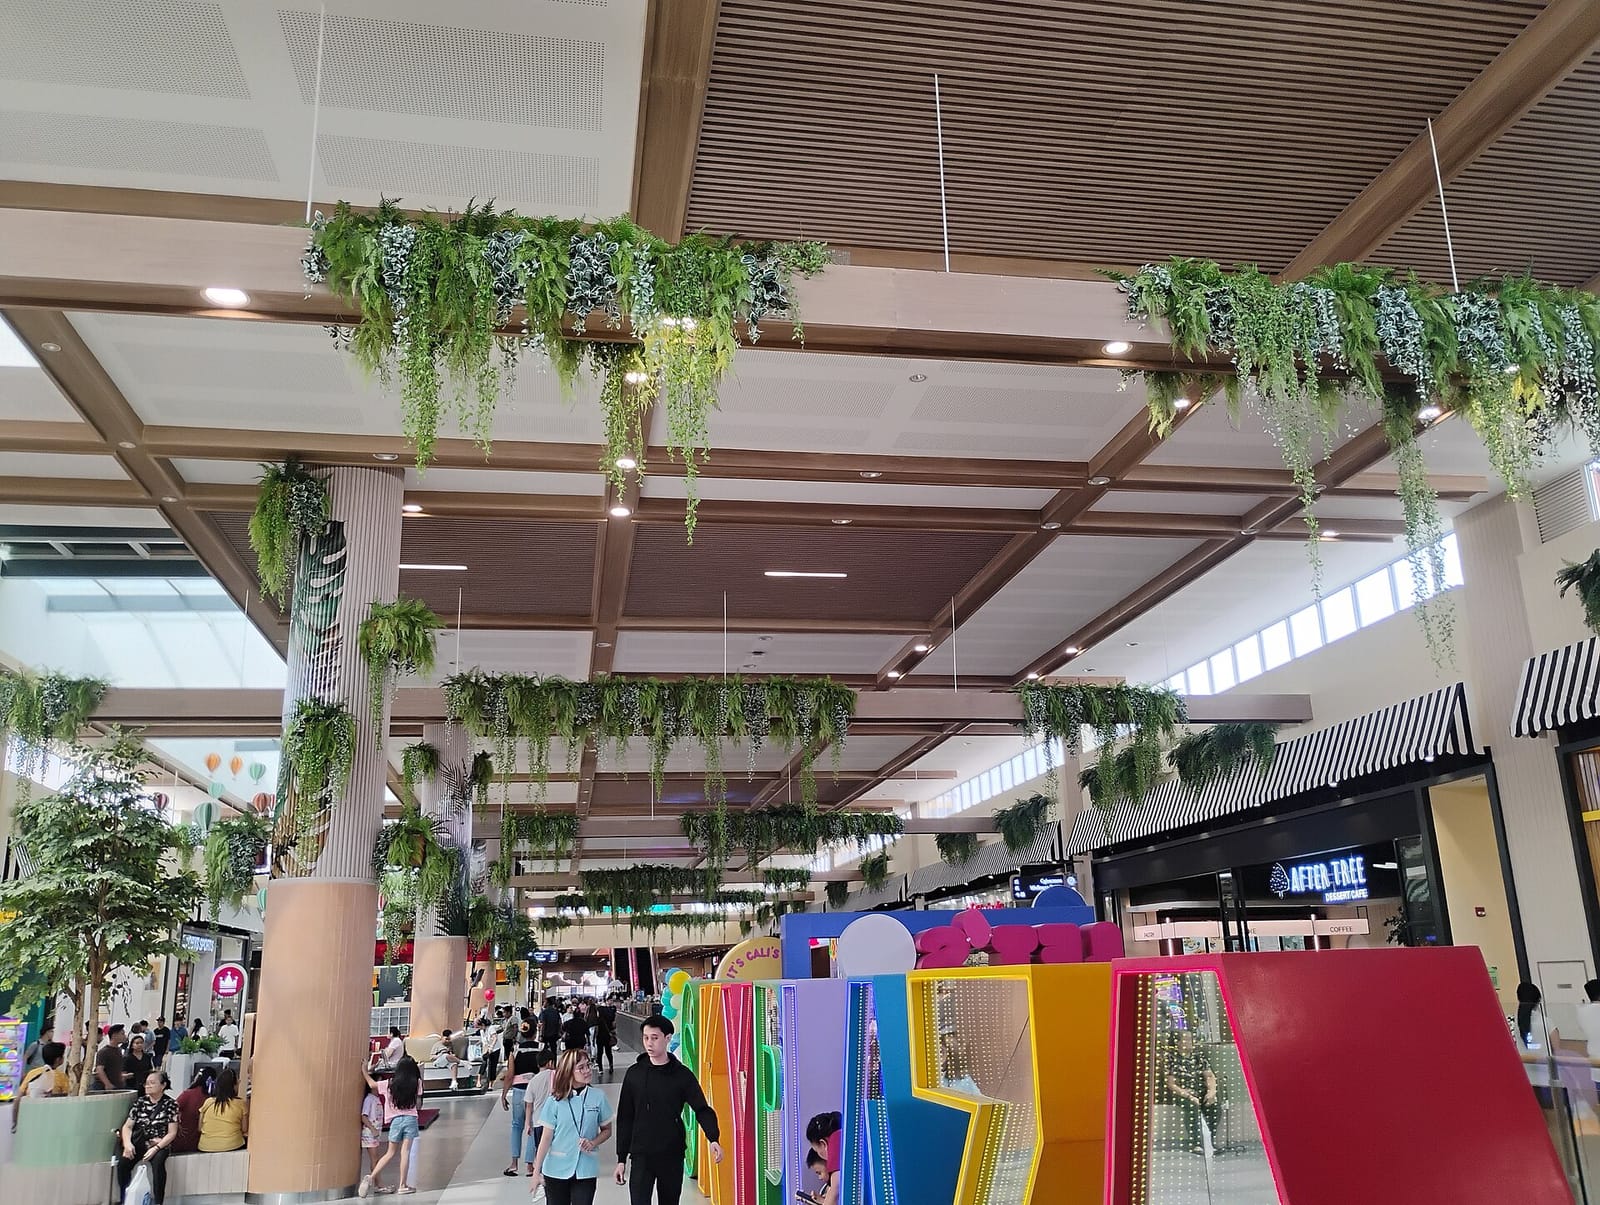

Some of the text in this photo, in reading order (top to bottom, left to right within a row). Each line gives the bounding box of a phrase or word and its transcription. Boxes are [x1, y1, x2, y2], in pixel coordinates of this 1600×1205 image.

[1291, 857, 1366, 892] AFTER TREE
[1325, 890, 1350, 902] DESSERT
[726, 946, 780, 979] IT'S CALI'S
